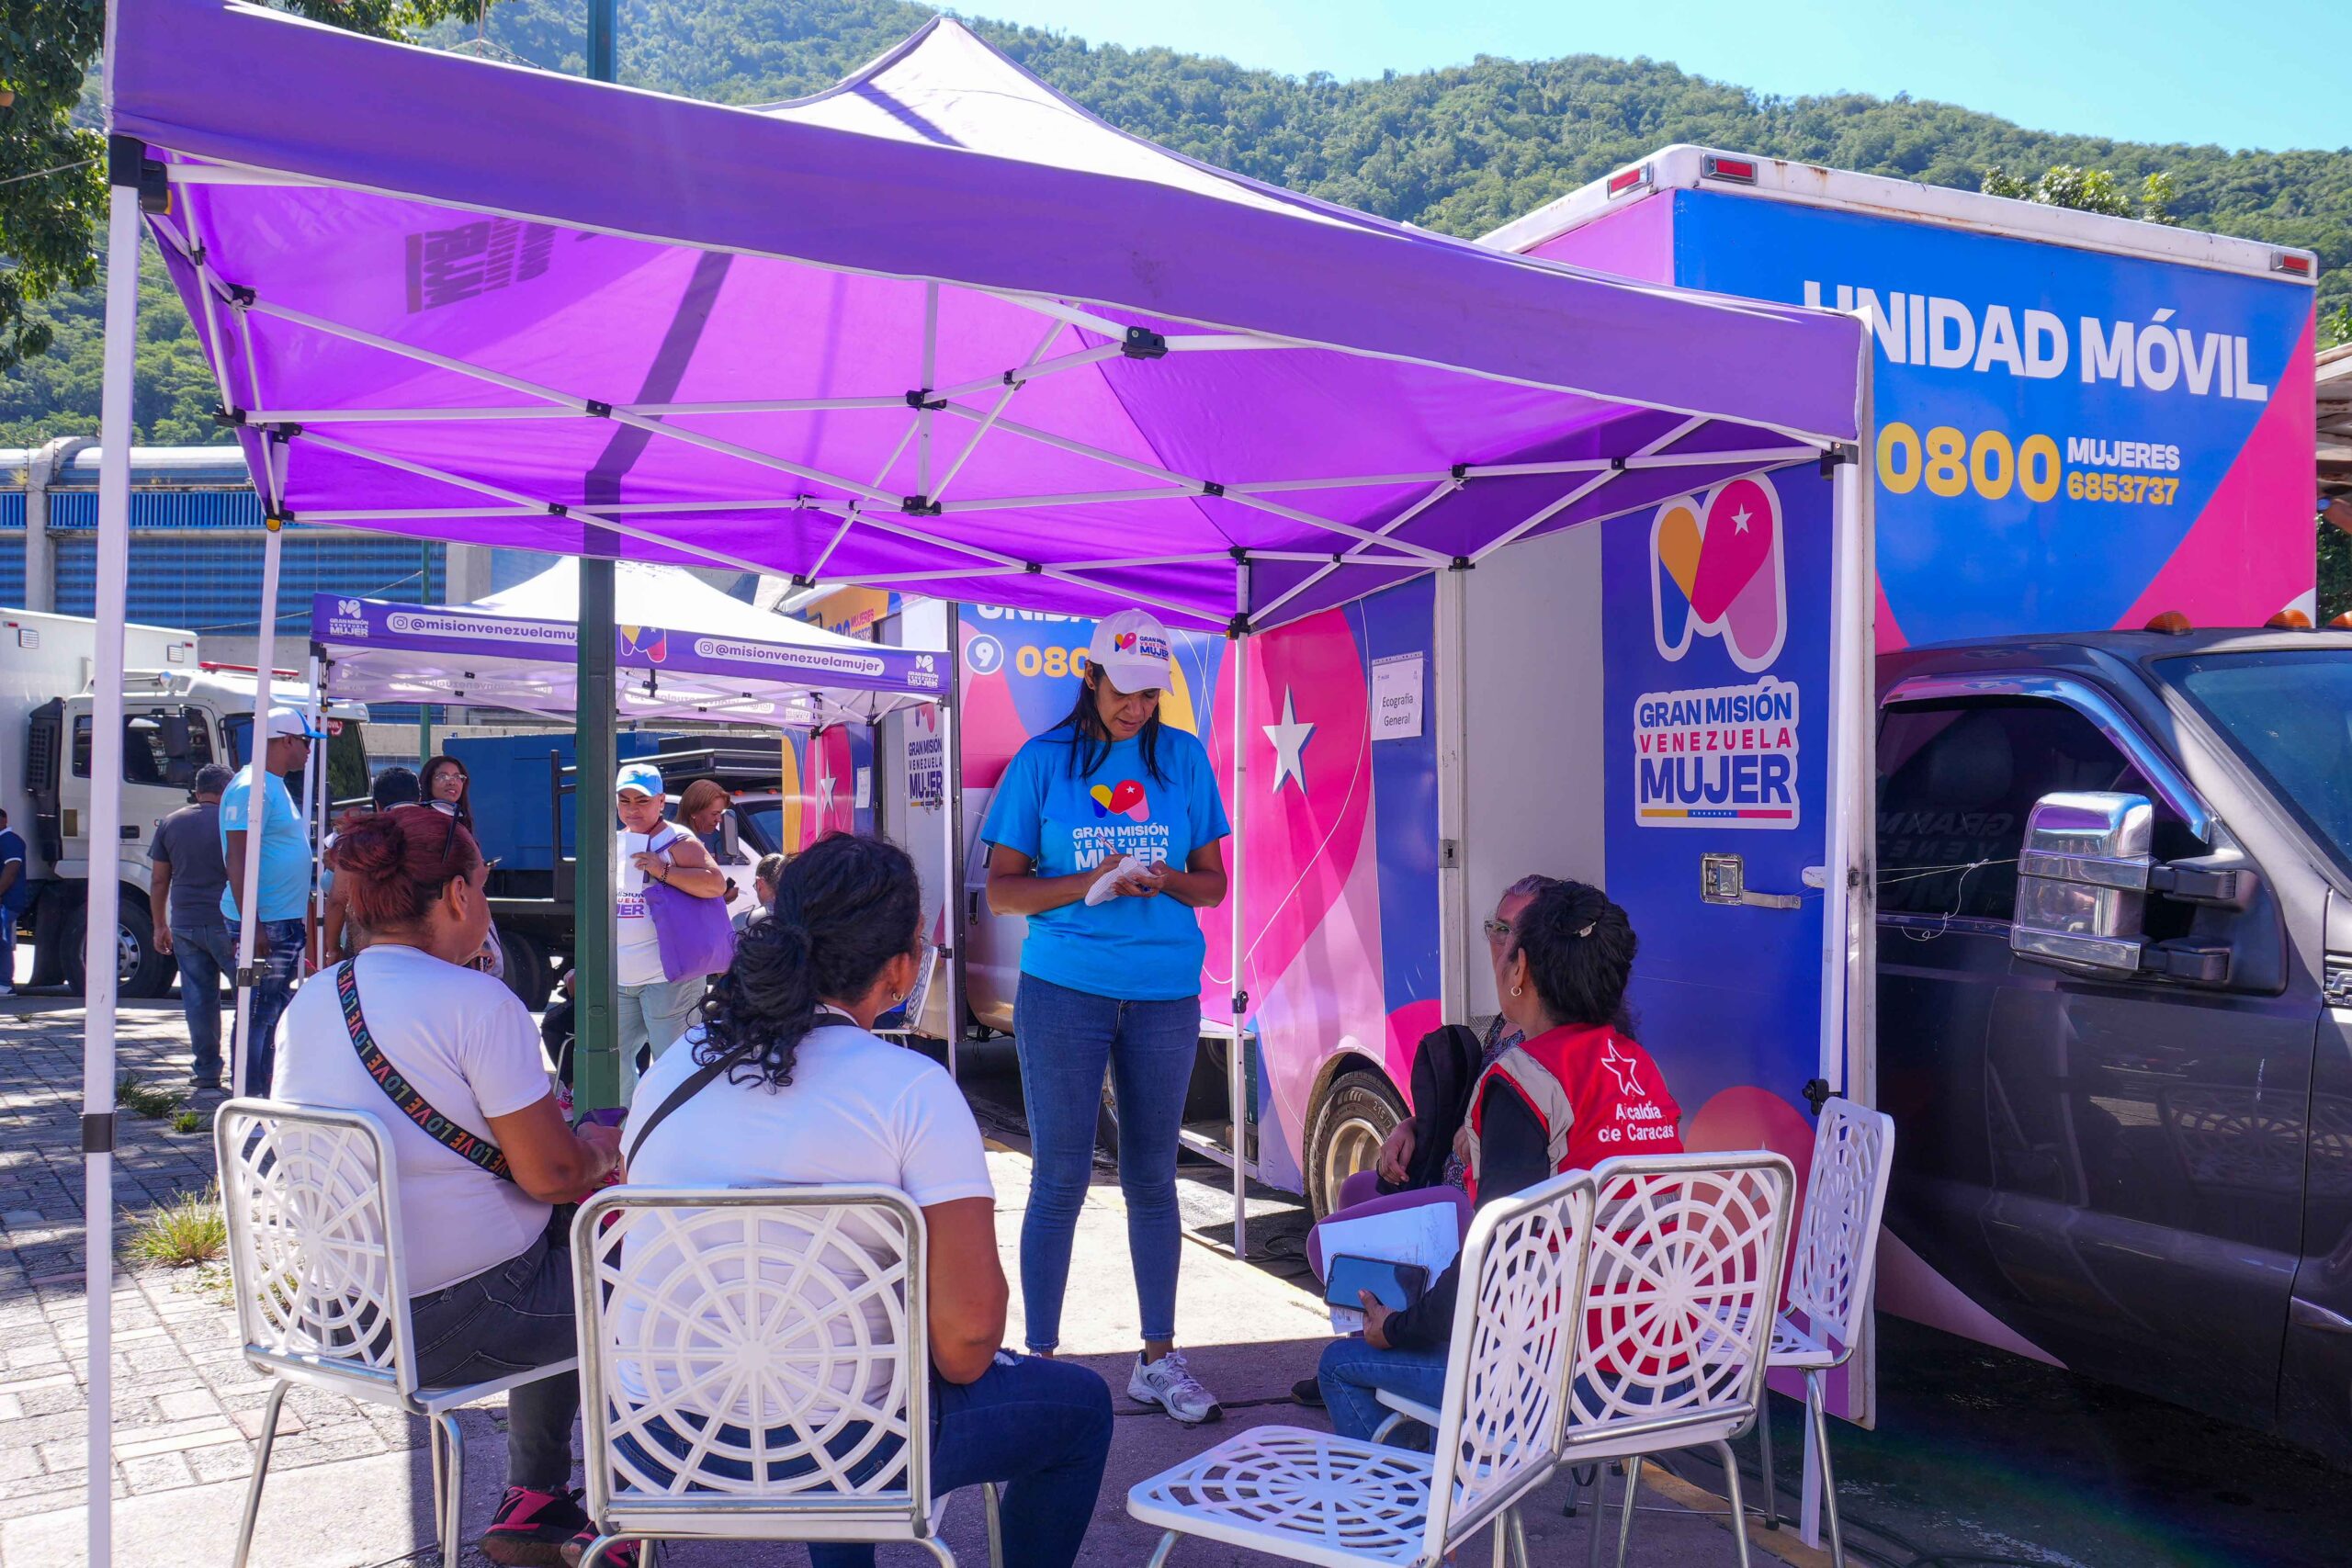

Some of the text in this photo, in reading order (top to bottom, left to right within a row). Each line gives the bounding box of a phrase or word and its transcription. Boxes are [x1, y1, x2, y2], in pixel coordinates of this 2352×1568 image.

[2079, 308, 2267, 401] MÓVIL
[1876, 422, 2061, 502] 0800
[2067, 436, 2180, 471] MUJERES
[2066, 470, 2179, 505] 6853737
[329, 626, 368, 637] MUJER
[411, 618, 579, 642] @misionvenezuelamu
[715, 644, 880, 674] @misionvenezuelamujer
[1139, 646, 1170, 658] MUJER
[1382, 693, 1414, 708] Ecografía
[1639, 685, 1792, 728] GRAN MISIÓN
[1384, 713, 1410, 727] General
[908, 734, 943, 757] GRAN MISIÓN
[1639, 727, 1792, 753] VENEZUELA
[908, 756, 943, 771] VENEZUELA
[909, 771, 944, 799] MUJER
[1640, 754, 1792, 805] MUJER
[1072, 823, 1170, 840] GRAN MISIÓN
[1073, 837, 1170, 850] VENEZUELA
[347, 1010, 375, 1057] LOVE
[366, 1053, 412, 1102] LOVE
[1615, 1100, 1662, 1120] Acaldía
[1627, 1122, 1675, 1142] Caracas
